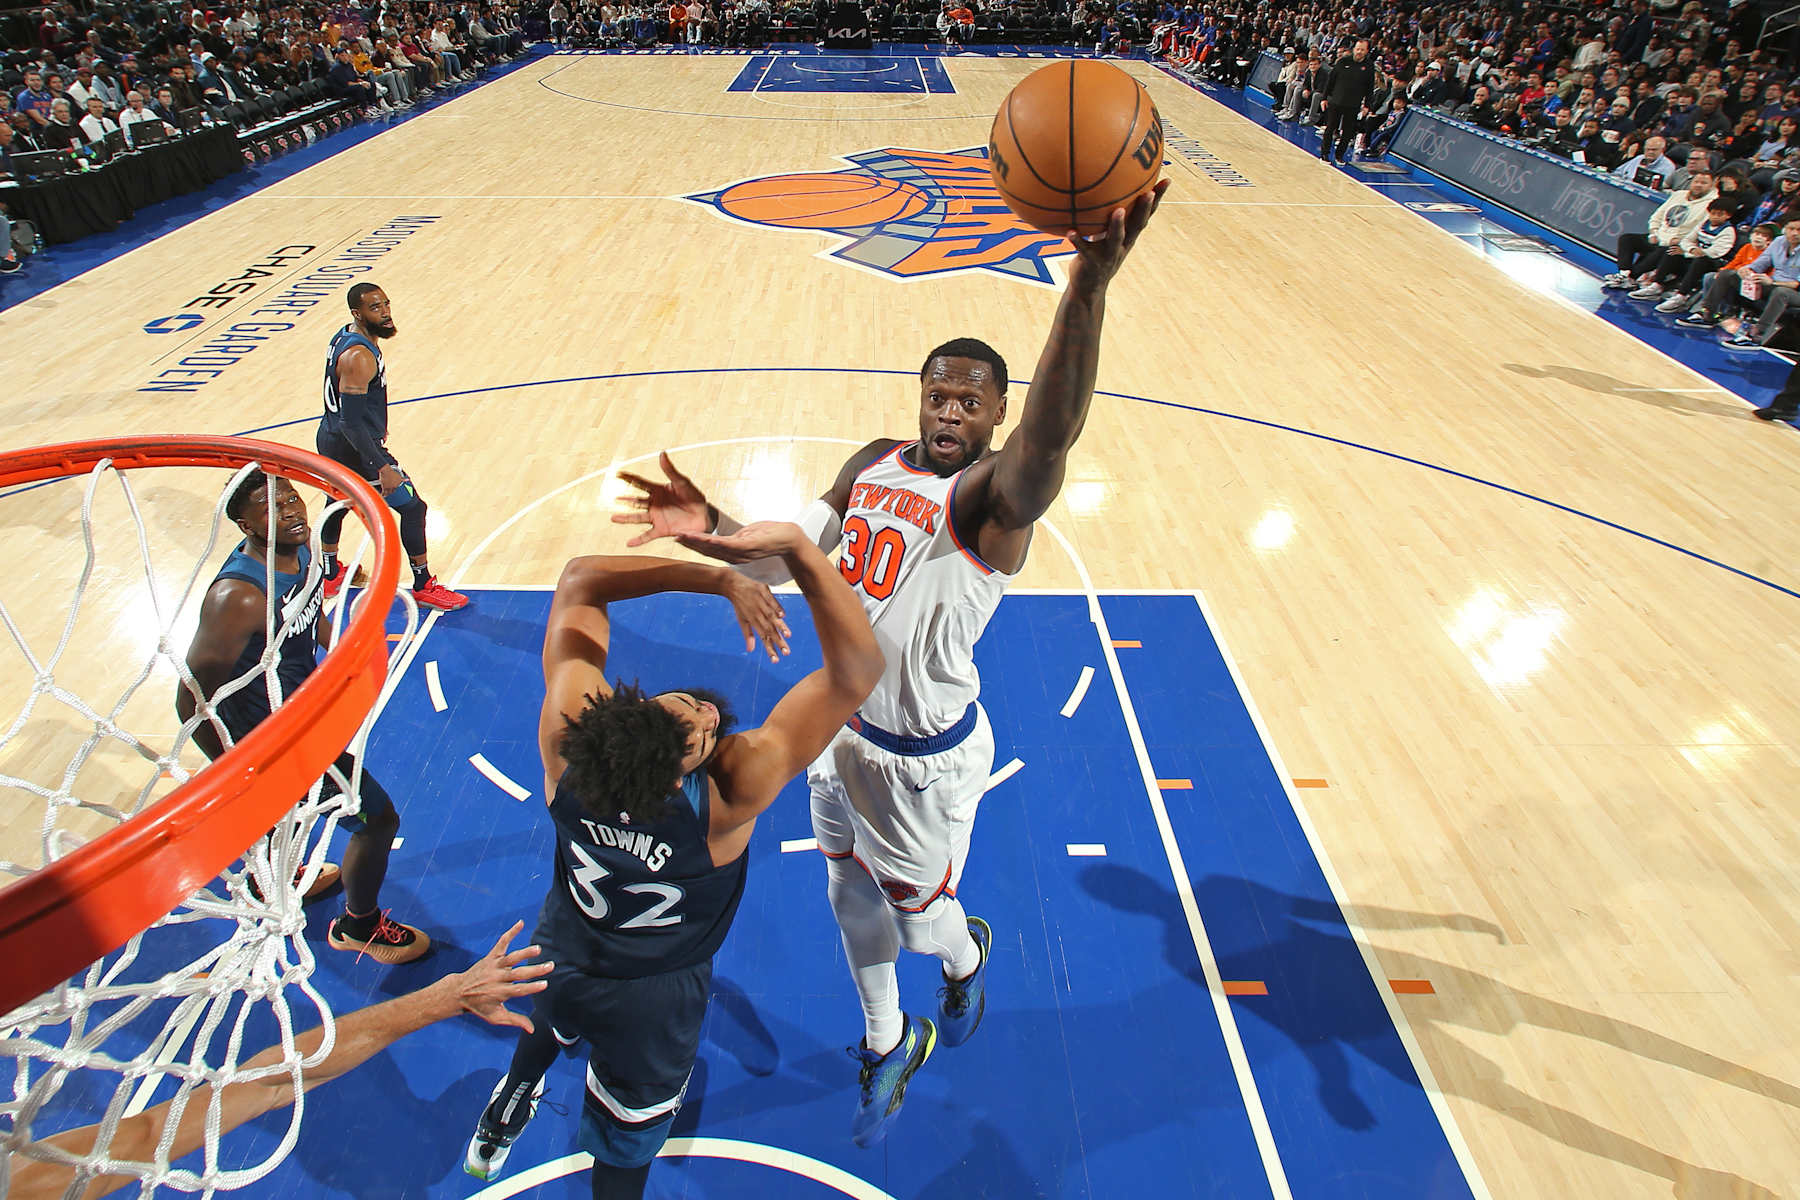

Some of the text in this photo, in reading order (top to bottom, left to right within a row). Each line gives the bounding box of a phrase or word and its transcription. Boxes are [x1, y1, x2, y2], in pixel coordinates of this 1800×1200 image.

[1405, 123, 1457, 162] Infosys
[1193, 161, 1257, 188] GARDEN
[1469, 146, 1534, 194] Infosys
[1552, 178, 1635, 238] Infosys
[333, 215, 442, 261] MADISON
[181, 244, 317, 309] CHASE
[250, 265, 373, 316] SQUARE
[136, 322, 296, 392] GARDEN
[882, 488, 942, 536] YORK
[840, 514, 906, 602] 30
[580, 818, 673, 872] TOWNS
[569, 840, 686, 929] 32
